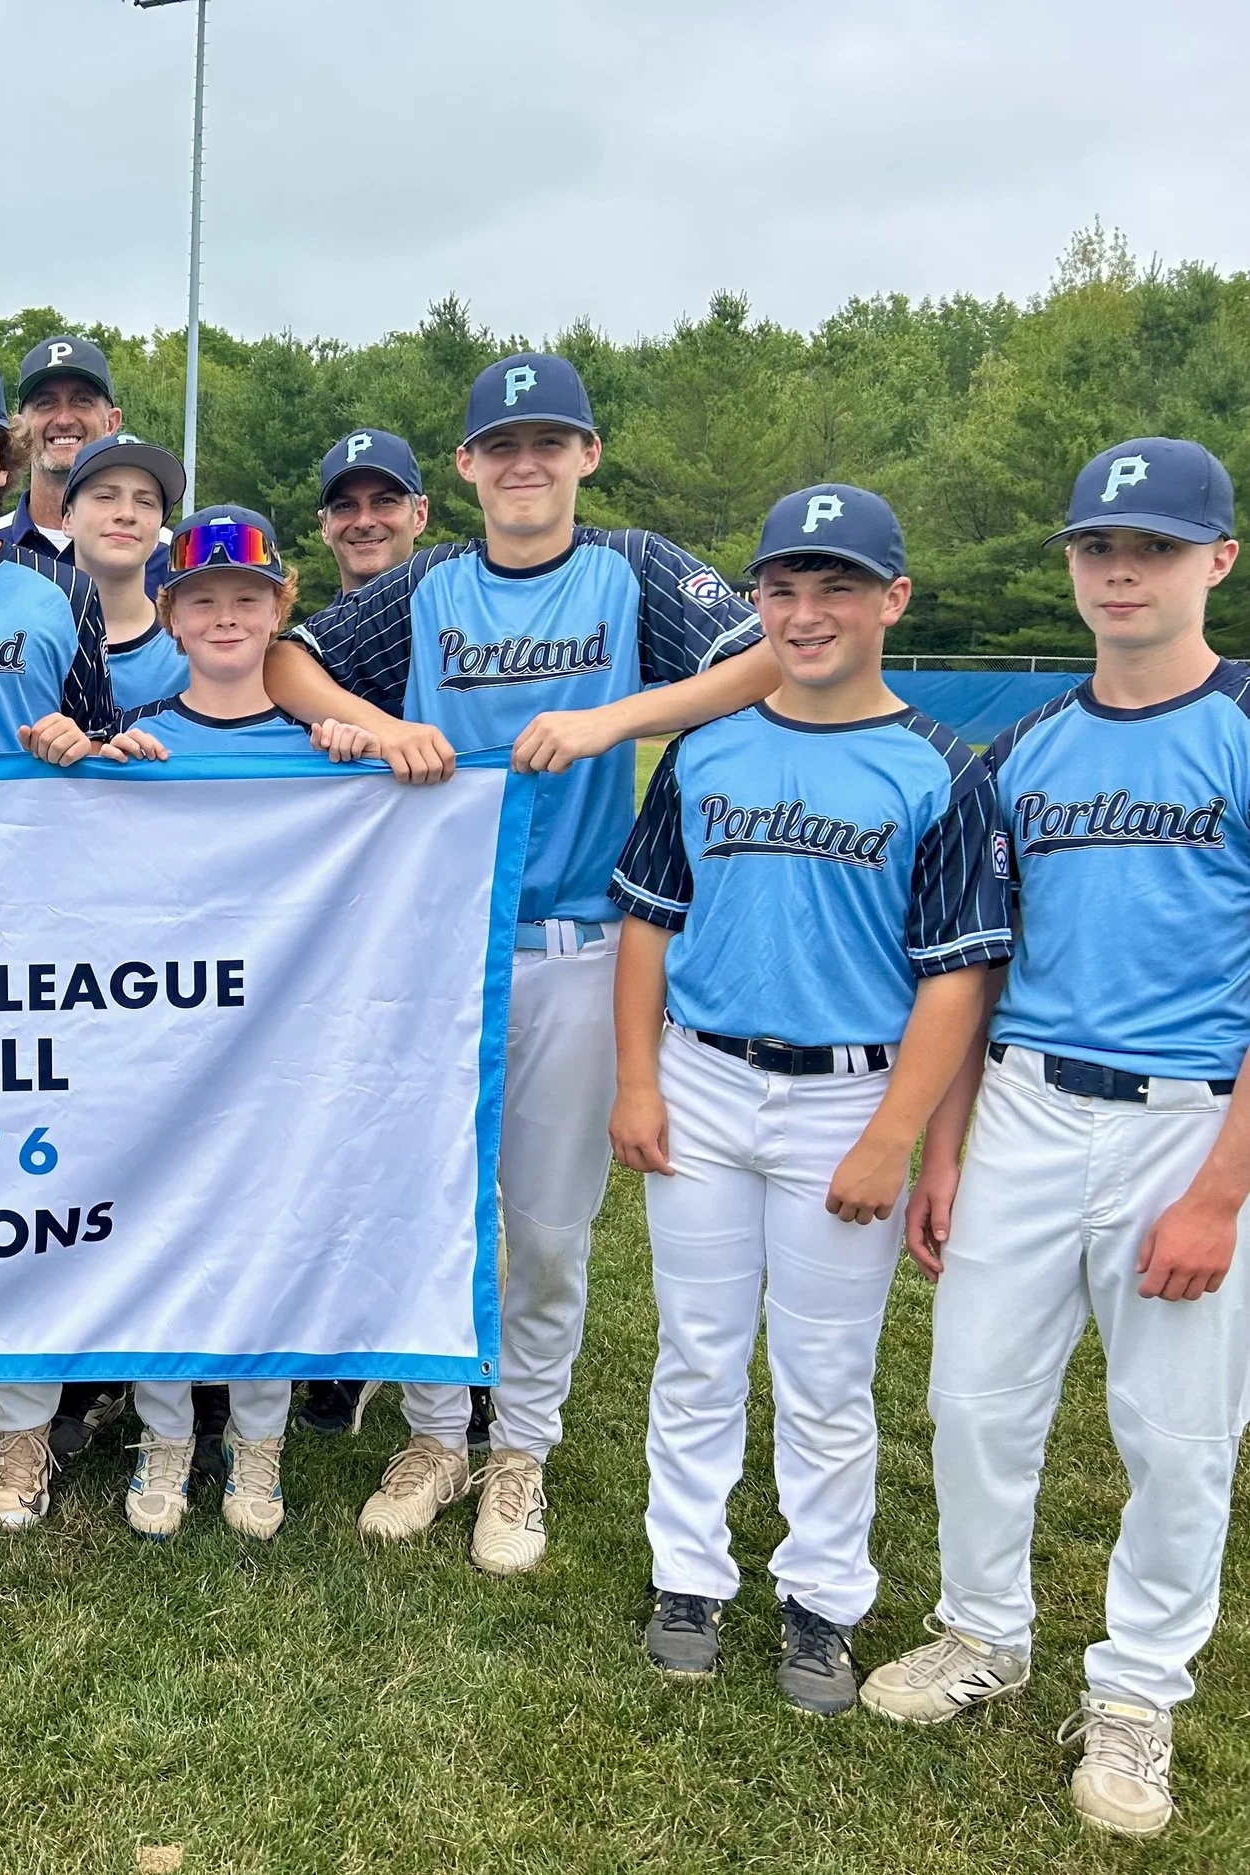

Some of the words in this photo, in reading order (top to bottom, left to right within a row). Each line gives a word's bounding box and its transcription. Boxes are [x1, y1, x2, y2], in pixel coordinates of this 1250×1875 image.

[47, 342, 73, 368] P
[504, 364, 538, 407] P
[346, 432, 373, 463] P
[1101, 453, 1151, 503] P
[801, 493, 845, 534] P
[439, 621, 611, 675] Portland
[700, 792, 898, 865] Portland
[1014, 788, 1228, 844] Portland
[18, 1126, 59, 1176] 6
